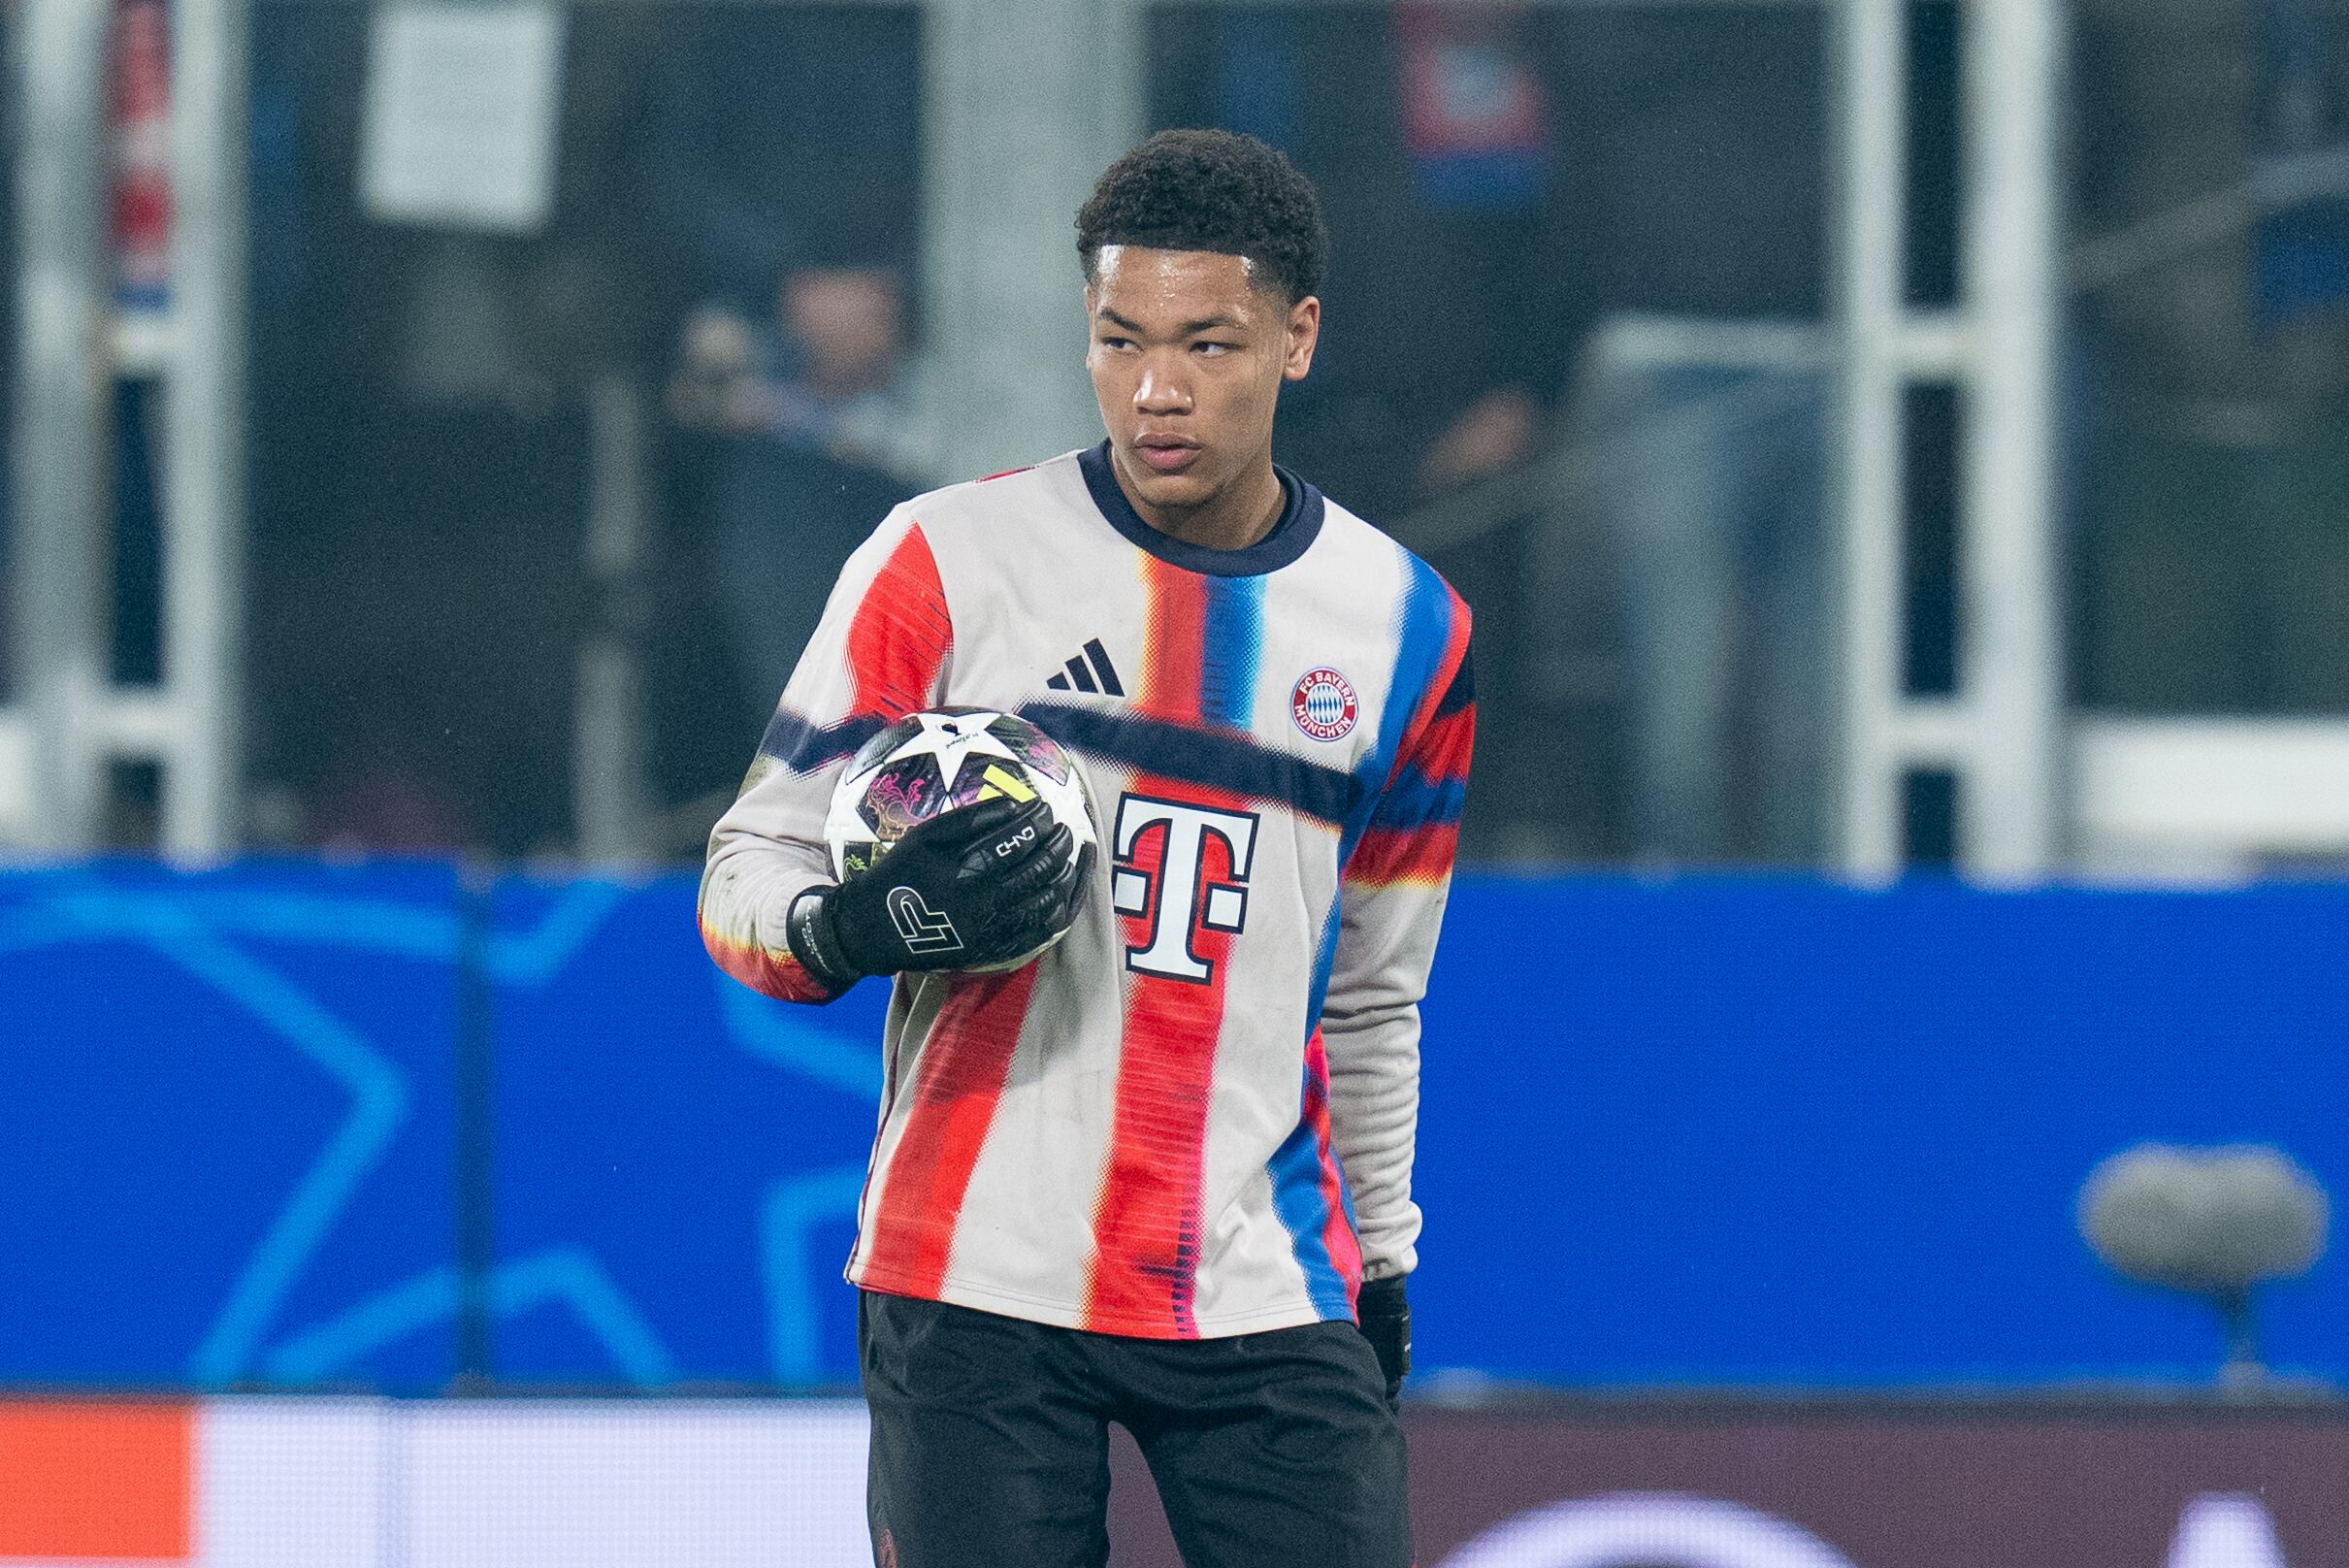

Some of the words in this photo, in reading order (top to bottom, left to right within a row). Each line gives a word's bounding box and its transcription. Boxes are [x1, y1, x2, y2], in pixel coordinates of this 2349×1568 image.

[1299, 676, 1315, 695] FC
[1315, 671, 1355, 706] BAYERN
[1112, 791, 1260, 986] T
